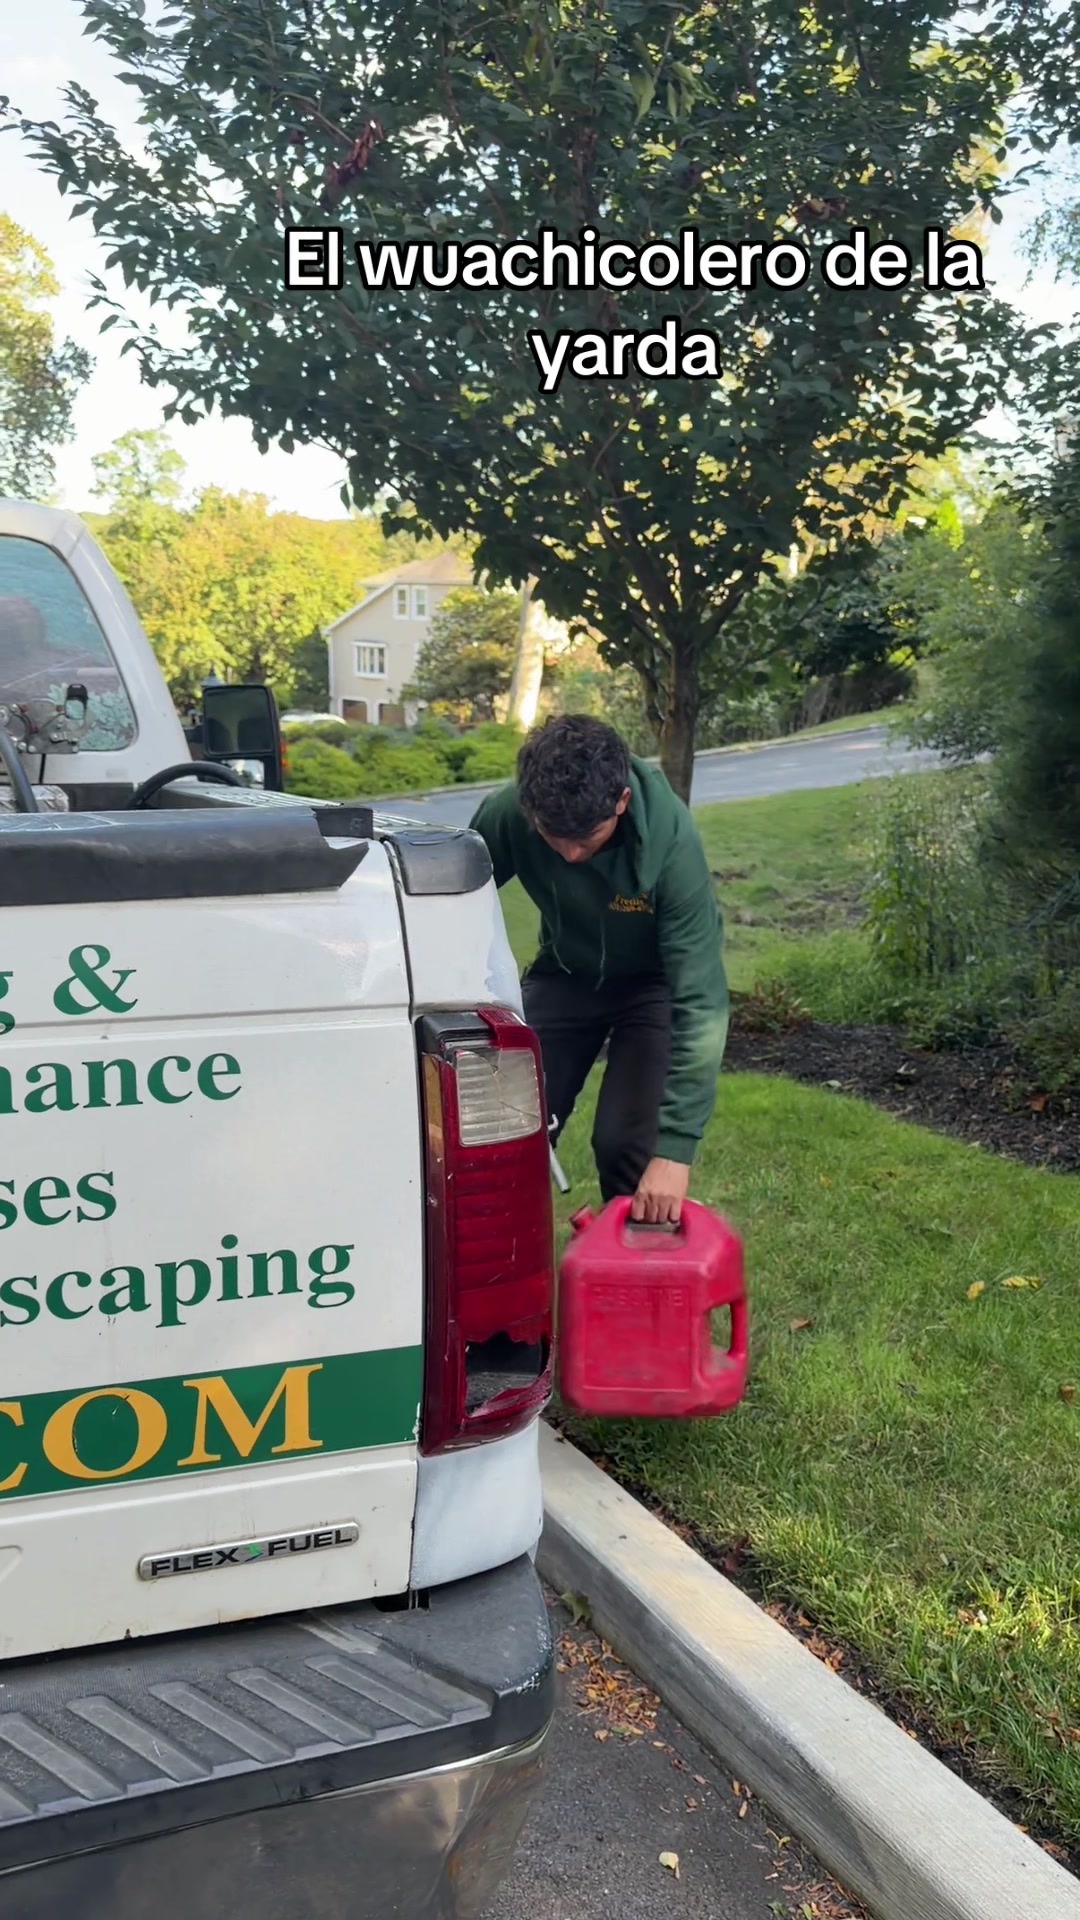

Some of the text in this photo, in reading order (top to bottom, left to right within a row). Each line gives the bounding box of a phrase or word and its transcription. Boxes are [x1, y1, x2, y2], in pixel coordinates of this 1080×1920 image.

[53, 944, 138, 1015] &
[0, 1234, 355, 1328] scaping
[0, 1363, 323, 1491] OM
[151, 1529, 352, 1576] FLEX FUEL
